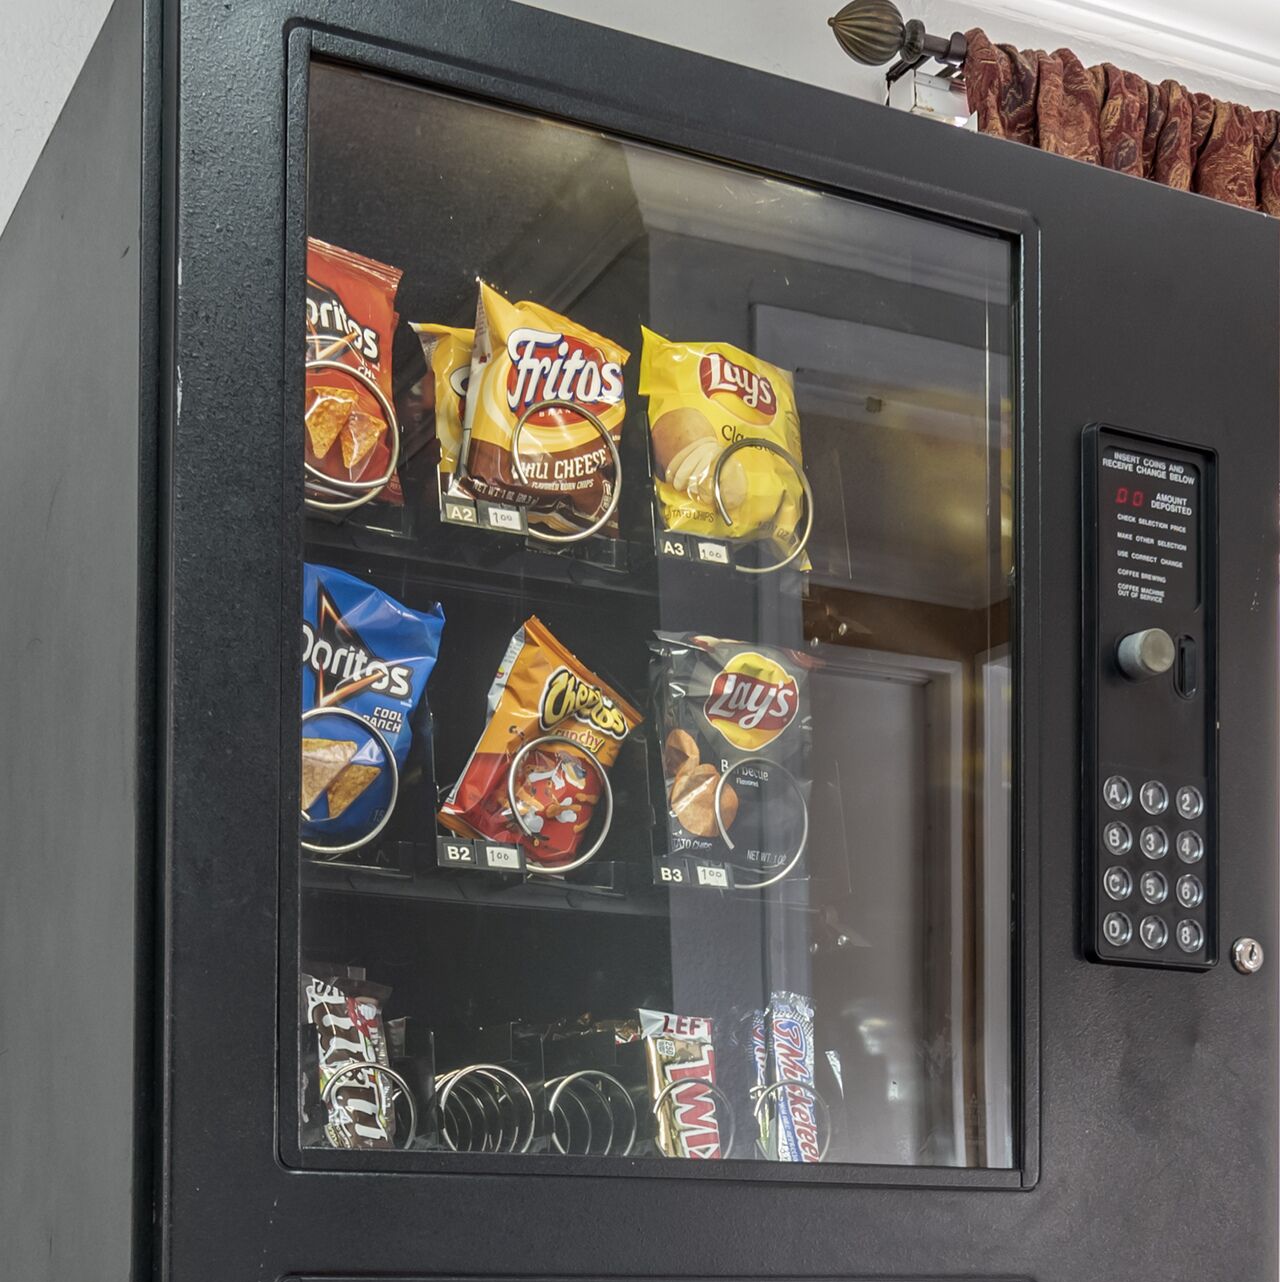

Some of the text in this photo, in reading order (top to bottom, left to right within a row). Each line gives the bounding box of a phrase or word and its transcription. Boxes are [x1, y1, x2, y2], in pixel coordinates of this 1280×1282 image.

[306, 298, 378, 359] oritos
[507, 327, 625, 412] Fritos
[709, 353, 771, 408] Lay's
[539, 408, 572, 418] BRAN
[554, 448, 607, 480] CHEESE
[1114, 452, 1184, 474] INSERT COINS AND
[1102, 458, 1195, 486] RECEIVE CHANGE BELOW
[1151, 500, 1192, 516] DEPOSITED
[1156, 493, 1187, 506] AMOUNT
[451, 506, 473, 522] A2
[1117, 513, 1186, 534] CHECK SELECTION PRICE
[664, 543, 685, 556] A3
[1117, 532, 1187, 551] MAKE OTHER SELECTION
[1117, 550, 1183, 569] USE CORRECT CHANGE
[1117, 568, 1166, 583] COFFEE BREWING
[1117, 583, 1165, 597] COFFEE MACHINE
[1140, 594, 1163, 603] SERVICE
[709, 674, 796, 729] Lay's
[373, 707, 402, 722] COOL
[1110, 784, 1120, 802] A
[1146, 789, 1153, 806] 1
[1181, 794, 1191, 811] 2
[1110, 829, 1120, 846] B
[1146, 834, 1155, 851] 3
[447, 846, 471, 861] B2
[1181, 838, 1191, 855] 4
[747, 850, 759, 861] NET
[661, 867, 683, 882] B3
[1109, 875, 1120, 892] C
[1146, 880, 1155, 896] 5
[1181, 884, 1190, 900] 6
[1146, 924, 1155, 941] 7
[1181, 927, 1190, 944] 8
[663, 1015, 713, 1035] LEFT
